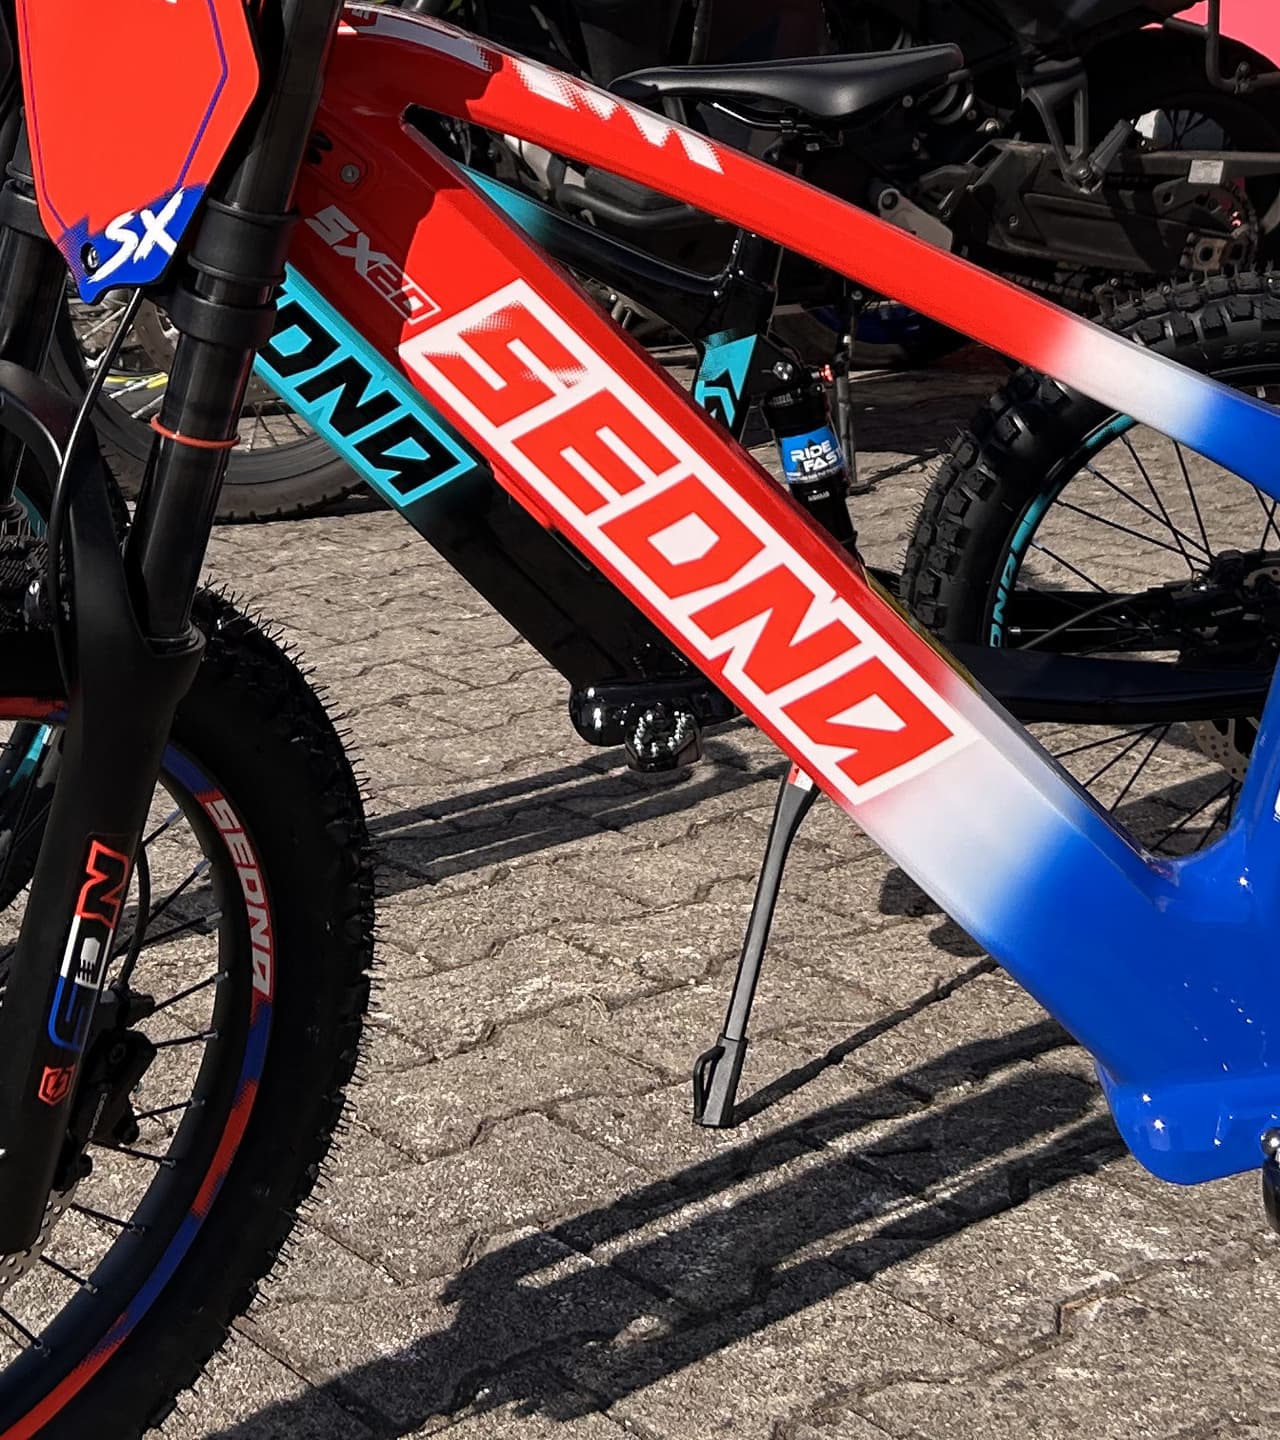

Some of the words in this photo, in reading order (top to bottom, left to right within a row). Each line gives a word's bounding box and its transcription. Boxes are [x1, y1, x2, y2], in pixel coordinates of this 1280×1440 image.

[86, 187, 184, 283] SX
[790, 440, 832, 463] RIDE
[420, 298, 954, 788] SEDNA
[204, 798, 271, 996] SEDNA
